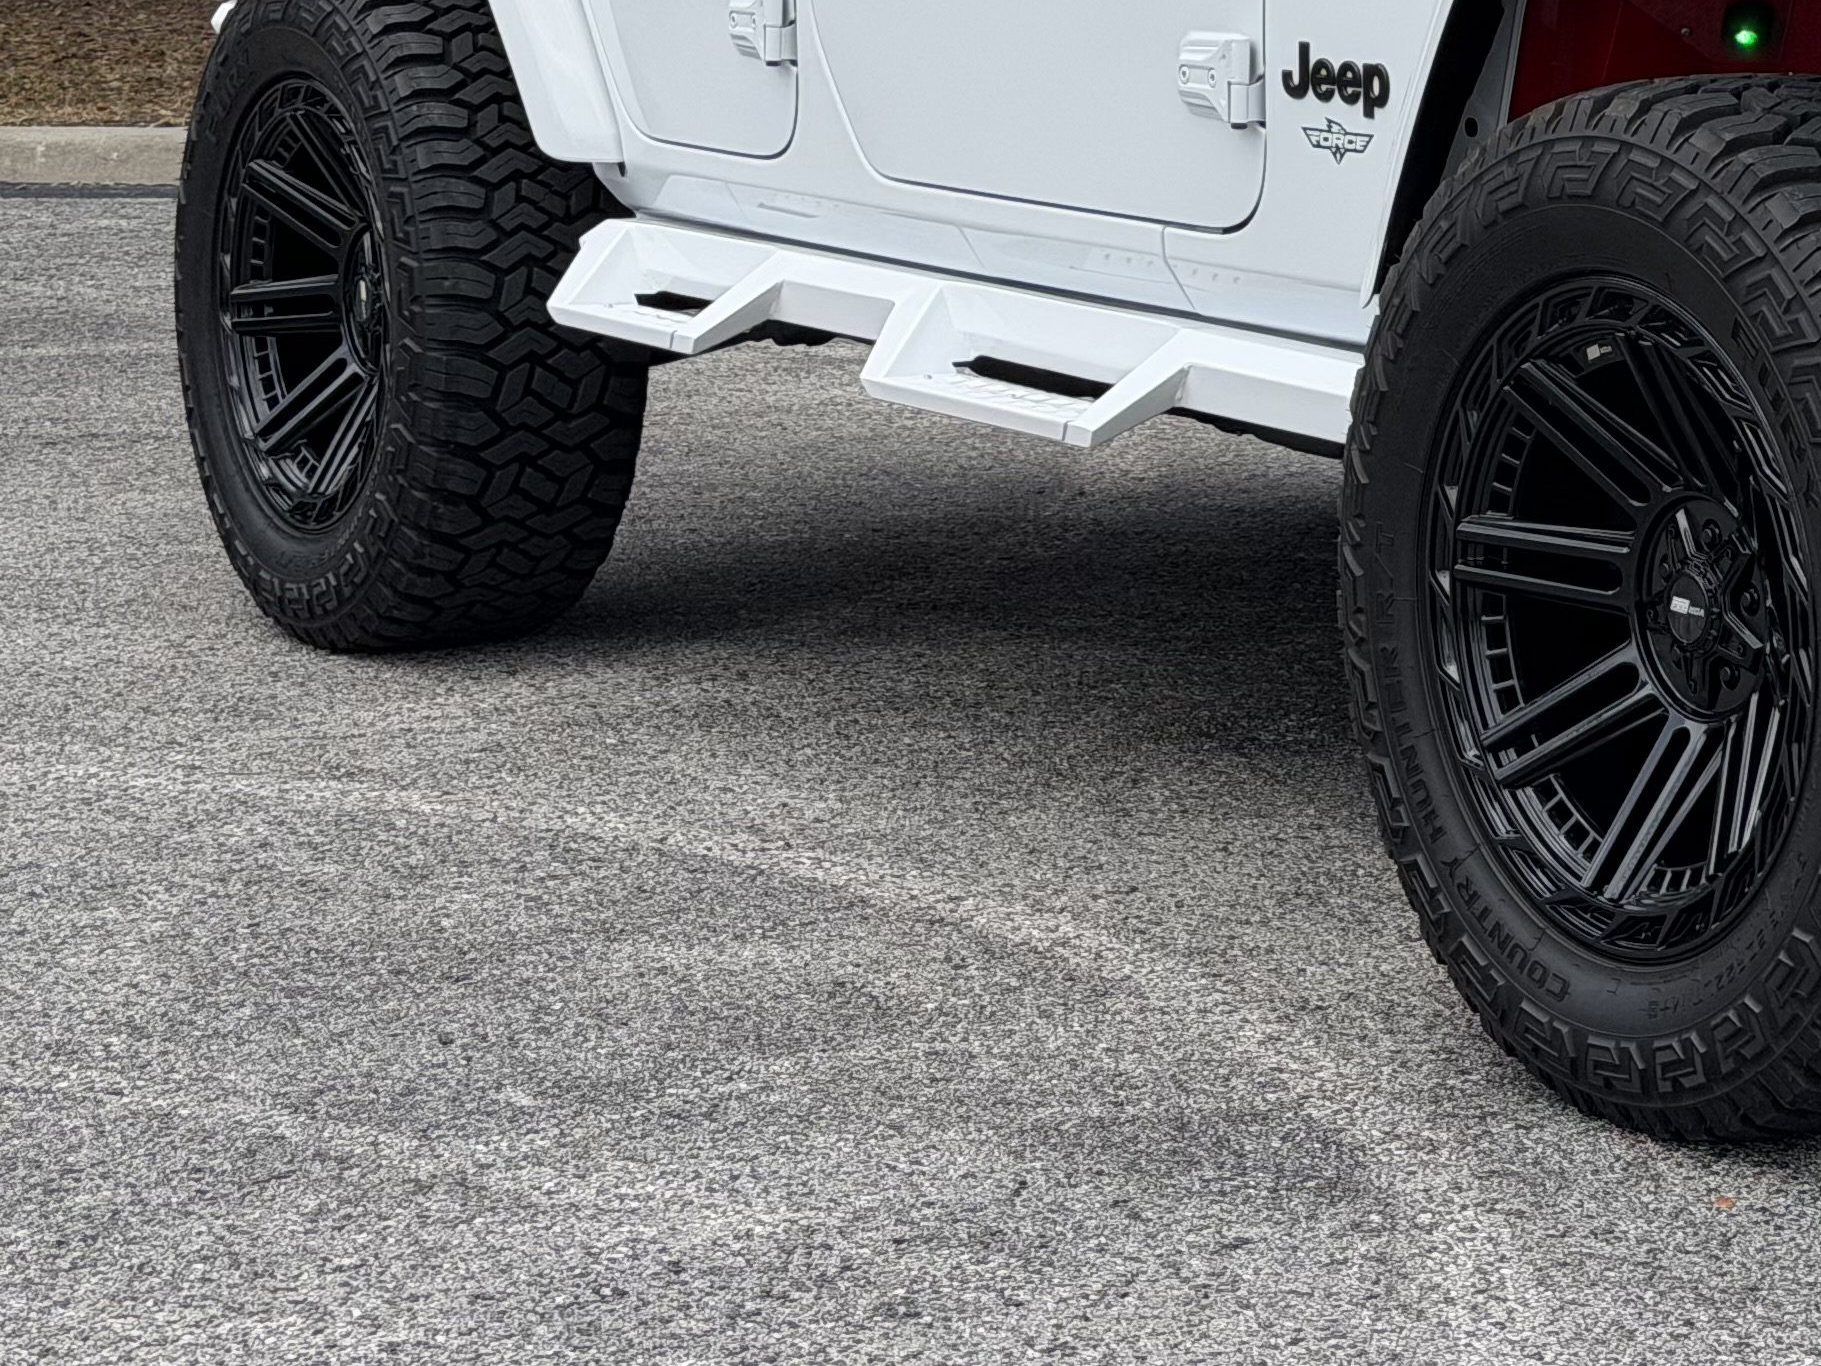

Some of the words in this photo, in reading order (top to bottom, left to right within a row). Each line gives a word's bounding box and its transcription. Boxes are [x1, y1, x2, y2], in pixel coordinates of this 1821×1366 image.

[1281, 40, 1391, 119] Jeep
[1303, 128, 1371, 152] FORCE
[1379, 644, 1447, 844] HUNTER
[1440, 851, 1570, 1005] COUNTRY
